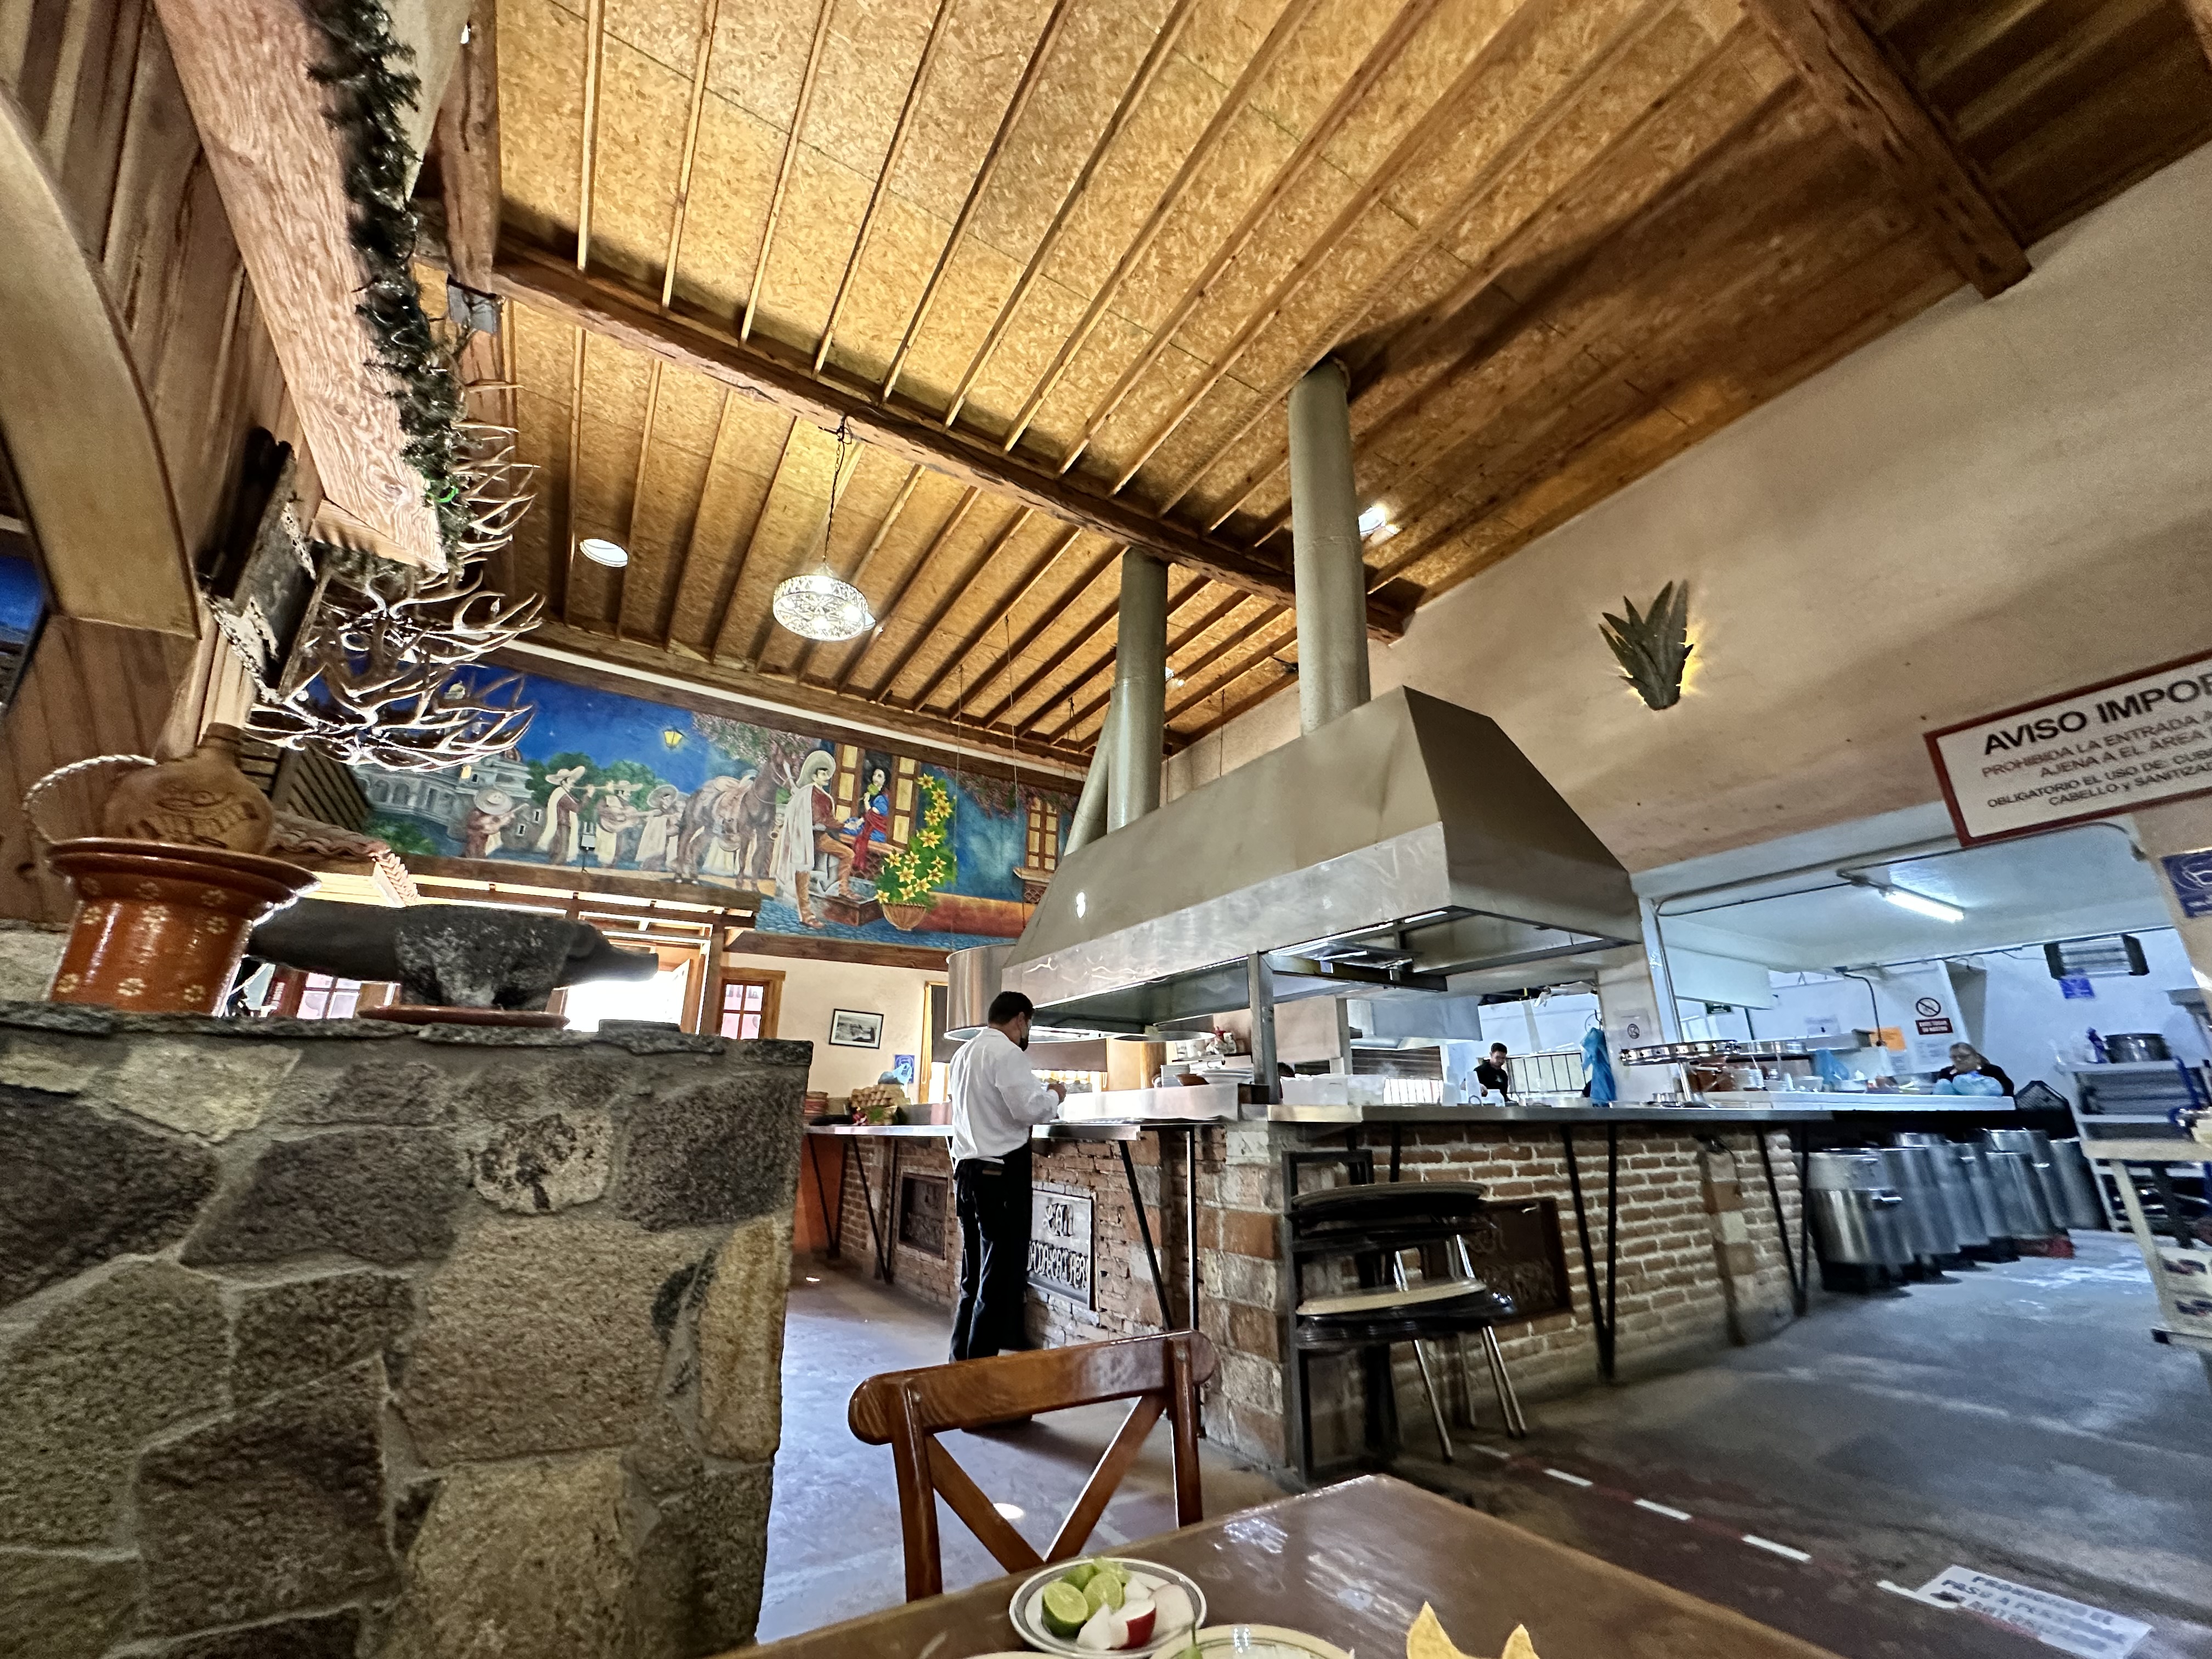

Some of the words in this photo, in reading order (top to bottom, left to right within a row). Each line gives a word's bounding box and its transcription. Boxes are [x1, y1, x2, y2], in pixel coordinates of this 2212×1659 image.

[1982, 747, 2074, 777] PROHIBIDA
[2076, 740, 2102, 753] LA
[2103, 715, 2200, 747] ENTRADA
[1984, 710, 2087, 755] AVISO
[1987, 780, 2080, 808] OBLIGATORIO
[2082, 775, 2102, 786] EL
[2104, 766, 2138, 780] USO
[2141, 759, 2166, 772] DE
[2040, 756, 2100, 777] AJENA
[2103, 751, 2118, 762] A
[2119, 746, 2145, 758] EL
[2049, 783, 2119, 806] CABELLO
